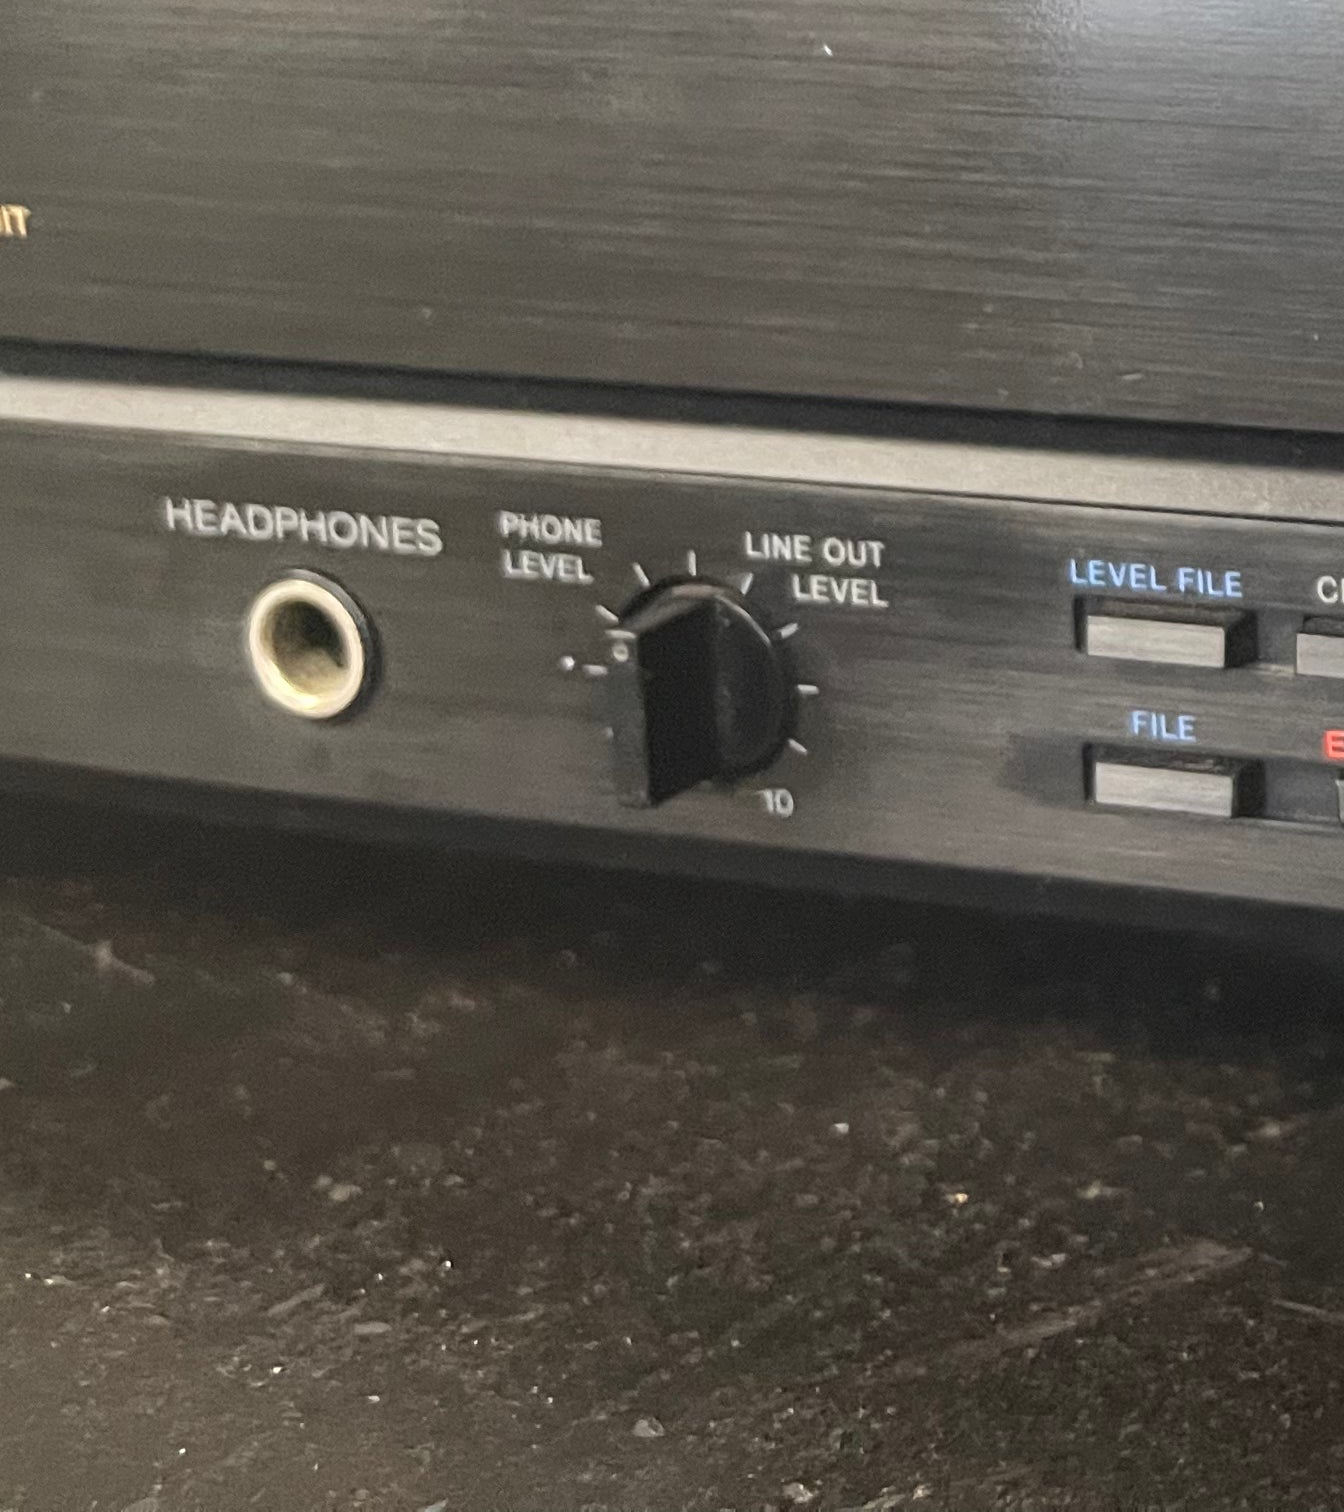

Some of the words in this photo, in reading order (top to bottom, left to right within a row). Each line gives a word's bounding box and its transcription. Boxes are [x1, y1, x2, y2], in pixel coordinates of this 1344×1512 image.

[163, 498, 443, 556] HEADPHONES
[499, 511, 602, 548] PHONE
[502, 550, 594, 585] LEVEL
[745, 531, 812, 563] LINE
[823, 537, 885, 569] OUT
[791, 574, 889, 608] LEVEL
[1069, 559, 1166, 594] LEVEL
[1178, 568, 1243, 598] FILE
[1132, 710, 1196, 741] FILE
[759, 788, 794, 818] 10
